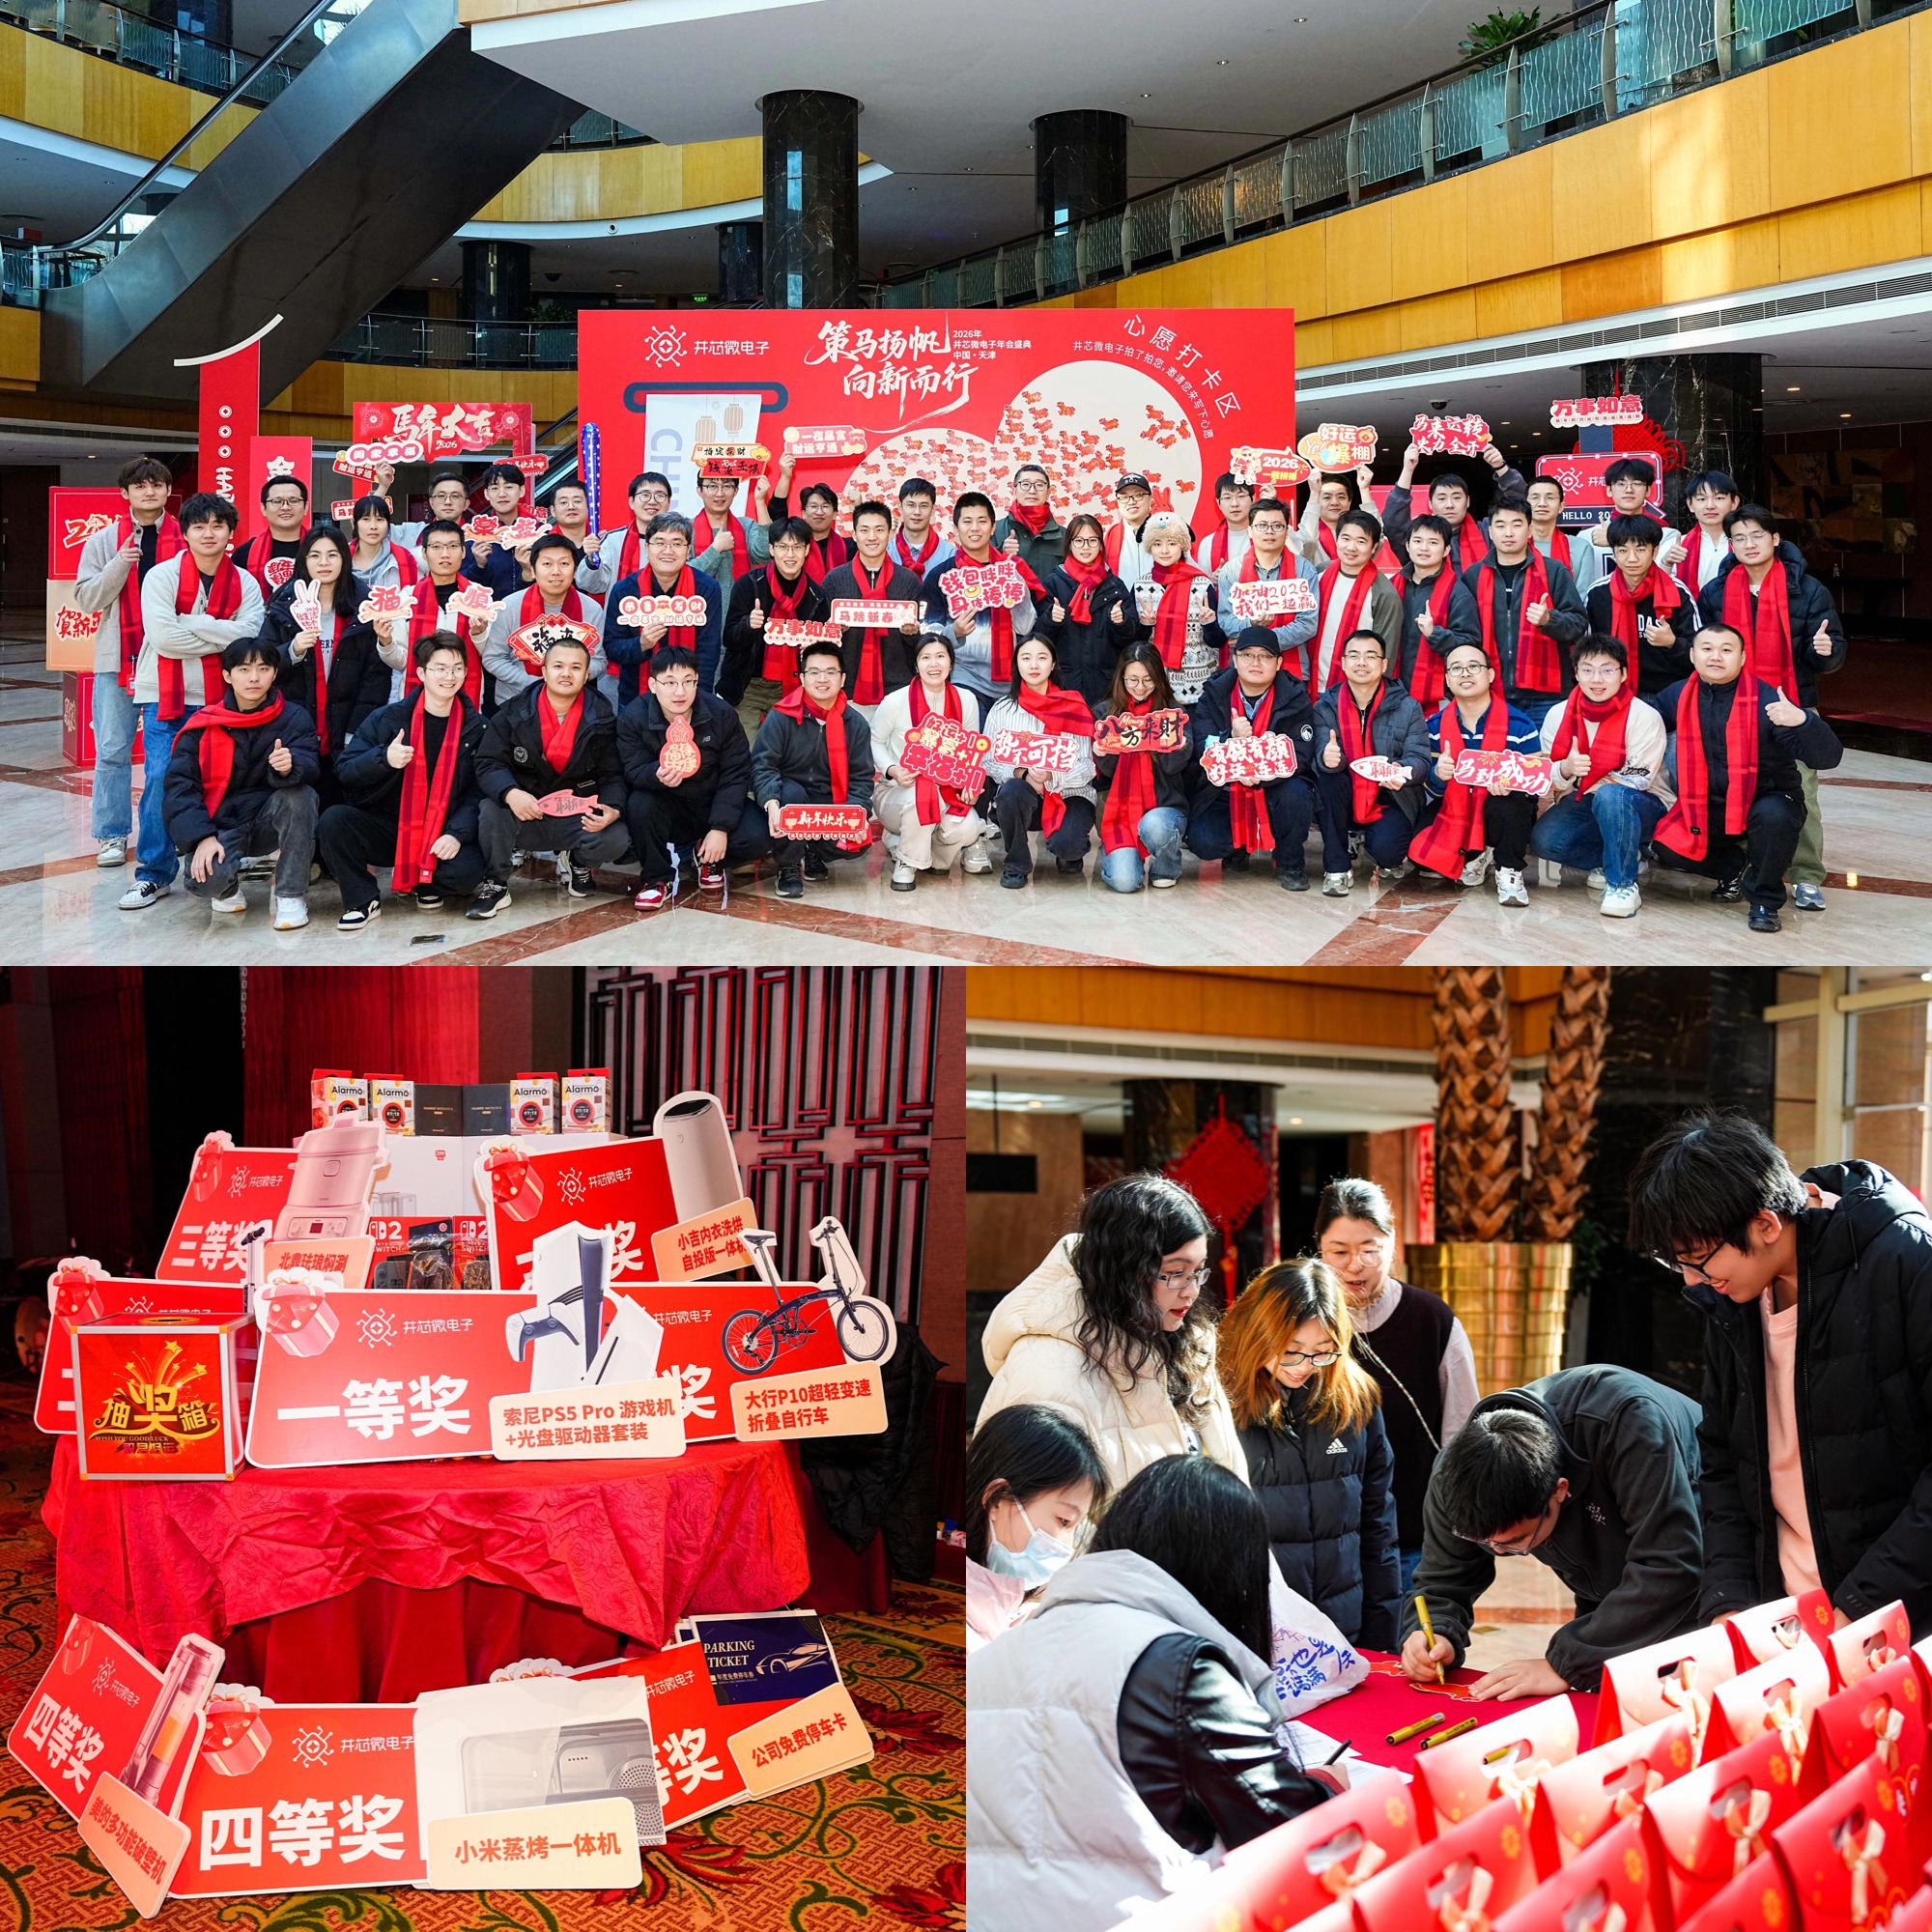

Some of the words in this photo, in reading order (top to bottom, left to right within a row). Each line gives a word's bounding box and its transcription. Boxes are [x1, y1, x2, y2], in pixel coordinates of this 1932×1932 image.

[804, 311, 952, 365] 策马扬帆
[952, 329, 982, 338] 2026年
[694, 340, 770, 355] 井芯微电子
[952, 340, 1032, 350] 井芯微电子年会盛典
[1123, 314, 1241, 419] 心愿打卡区
[843, 361, 980, 434] 向新而行
[1553, 395, 1642, 416] 万事如意
[801, 430, 846, 442] 一夜暴富
[1321, 426, 1357, 443] 好运
[1413, 413, 1484, 440] 马来运转
[436, 440, 458, 450] 2026
[792, 442, 838, 455] 财运亨通
[1328, 444, 1371, 465] 爆棚
[1416, 438, 1481, 457] 火力全开
[1263, 456, 1298, 469] 2026
[1562, 511, 1593, 520] HELLO
[941, 560, 1015, 594] 钱包胖胖
[369, 586, 401, 612] 福
[950, 580, 1025, 617] 身体棒棒
[1232, 580, 1309, 600] 加油2026
[839, 611, 894, 623] 马踏新春
[767, 617, 841, 639] 万事如意
[1119, 715, 1146, 726] Money
[924, 715, 978, 749] 好运+1
[994, 728, 1079, 769] 势不可挡
[1209, 760, 1290, 782] 好运连连
[1455, 752, 1551, 795] 马到成功
[797, 810, 849, 829] 新年快乐
[331, 1085, 363, 1095] Alarmo
[377, 1088, 409, 1097] Alarmo
[514, 1088, 548, 1096] Alarmo
[565, 1085, 600, 1094] Alarmo
[249, 1175, 284, 1187] 井芯微电子
[587, 1167, 634, 1189] 井芯微电子
[388, 1220, 403, 1239] 2
[678, 1215, 744, 1251] 小吉内衣洗烘
[403, 1318, 474, 1335] 井芯微电子
[653, 1309, 713, 1326] 井芯微电子
[744, 1378, 872, 1410] 大行P10超轻变速
[97, 1381, 211, 1435] 抽奖箱
[277, 1374, 472, 1441] 一等奖
[503, 1406, 578, 1427] 索尼PS5
[582, 1404, 615, 1420] Pro
[619, 1398, 675, 1419] 游戏机
[747, 1406, 829, 1434] 折叠自行车
[505, 1422, 648, 1449] +光盘驱动器套装
[703, 1639, 755, 1654] PARKING
[707, 1654, 750, 1668] TICKET
[111, 1678, 141, 1709] 井芯微电子
[645, 1669, 696, 1699] 井芯微电子
[22, 1692, 105, 1794] 四等奖
[340, 1735, 415, 1754] 井芯微电子
[752, 1712, 848, 1769] 公司免费停车卡
[89, 1795, 167, 1886] 美的多功能破壁机
[199, 1793, 406, 1871] 四等奖
[454, 1832, 622, 1865] 小米蒸烤一体机
